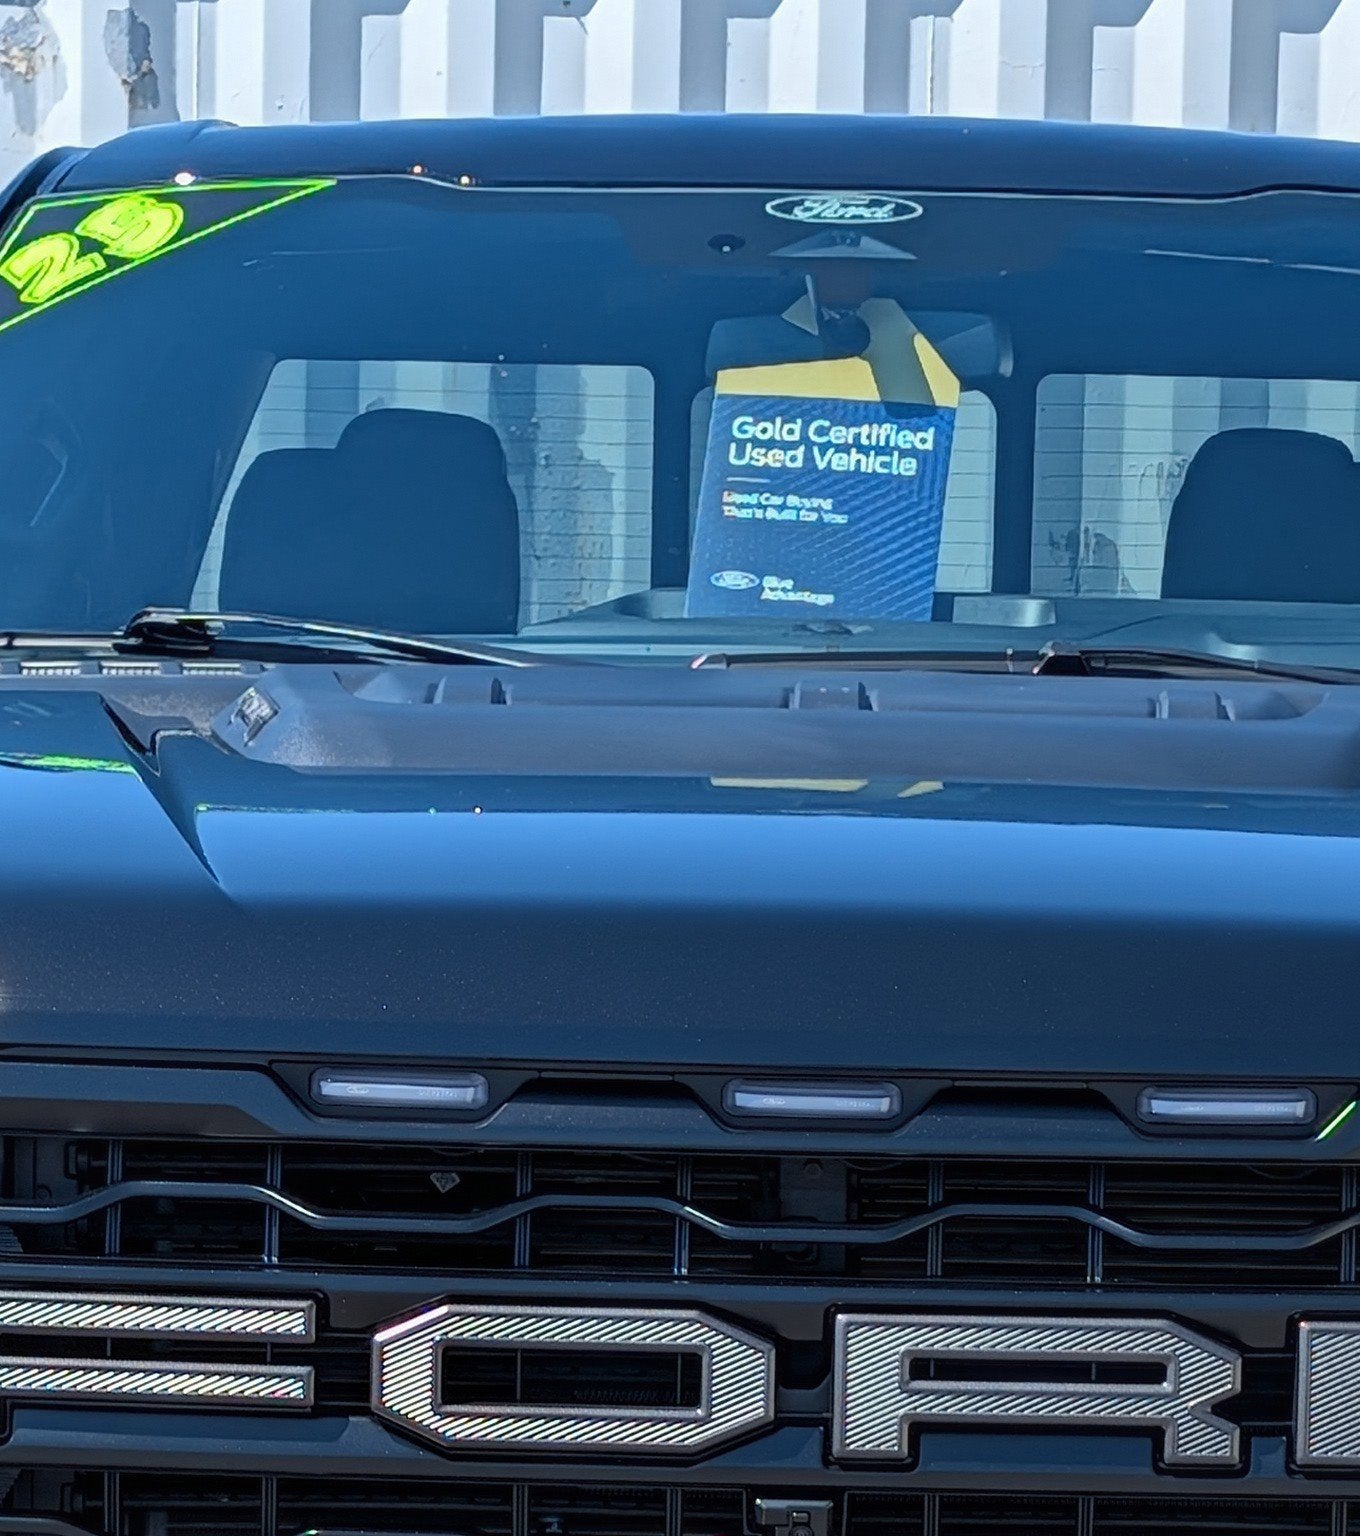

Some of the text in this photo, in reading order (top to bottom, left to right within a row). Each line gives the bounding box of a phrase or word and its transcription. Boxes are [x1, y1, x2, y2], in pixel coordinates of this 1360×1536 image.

[790, 195, 897, 220] Ford
[732, 416, 936, 450] Gold Certified
[728, 442, 918, 476] Used Vehicle
